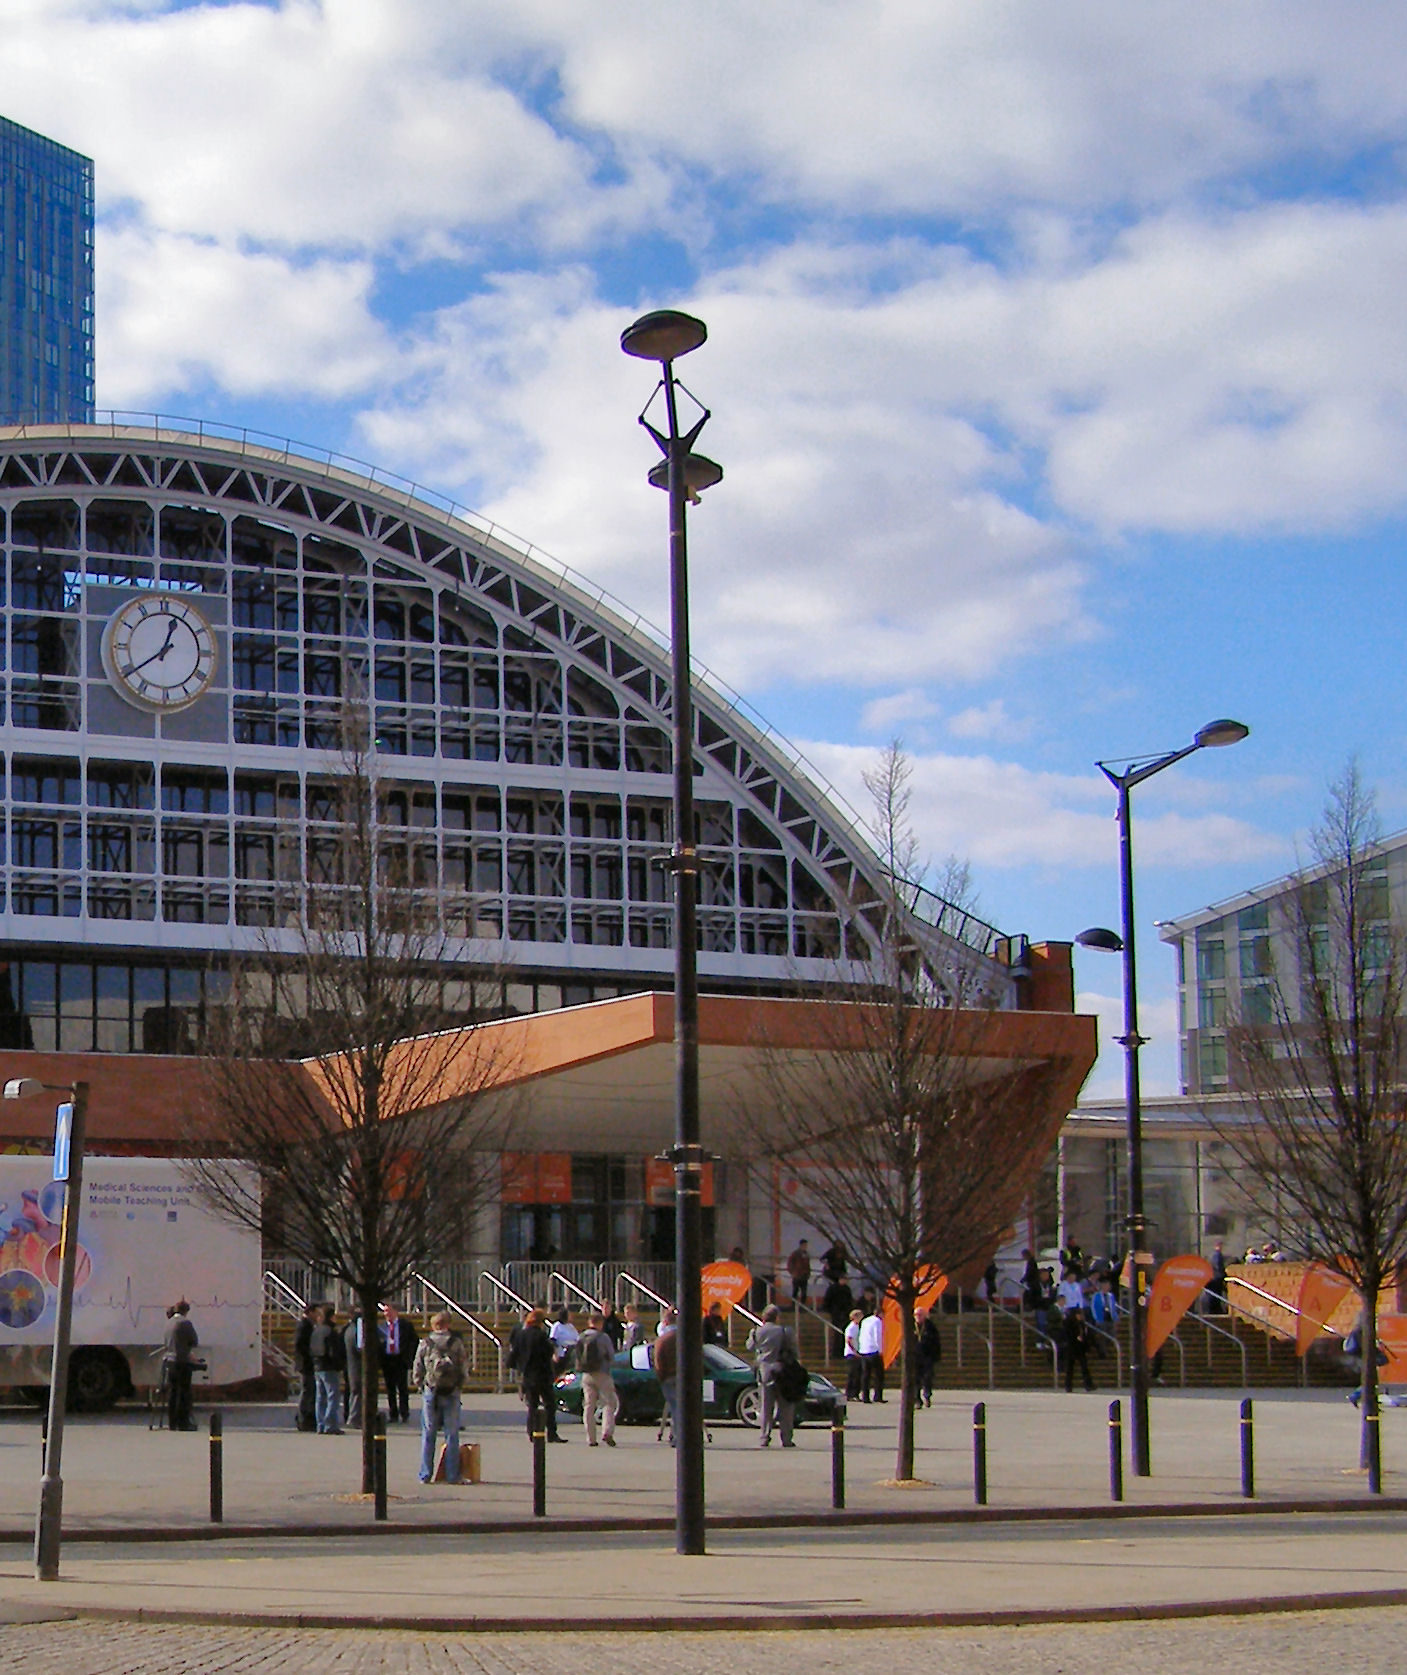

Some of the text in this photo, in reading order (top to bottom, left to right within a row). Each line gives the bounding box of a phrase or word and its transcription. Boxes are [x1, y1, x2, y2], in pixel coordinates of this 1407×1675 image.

[89, 1182, 127, 1193] Medical
[129, 1182, 172, 1194] Sciences
[89, 1195, 191, 1208] Mobile Teaching Unit
[1160, 1295, 1172, 1313] B
